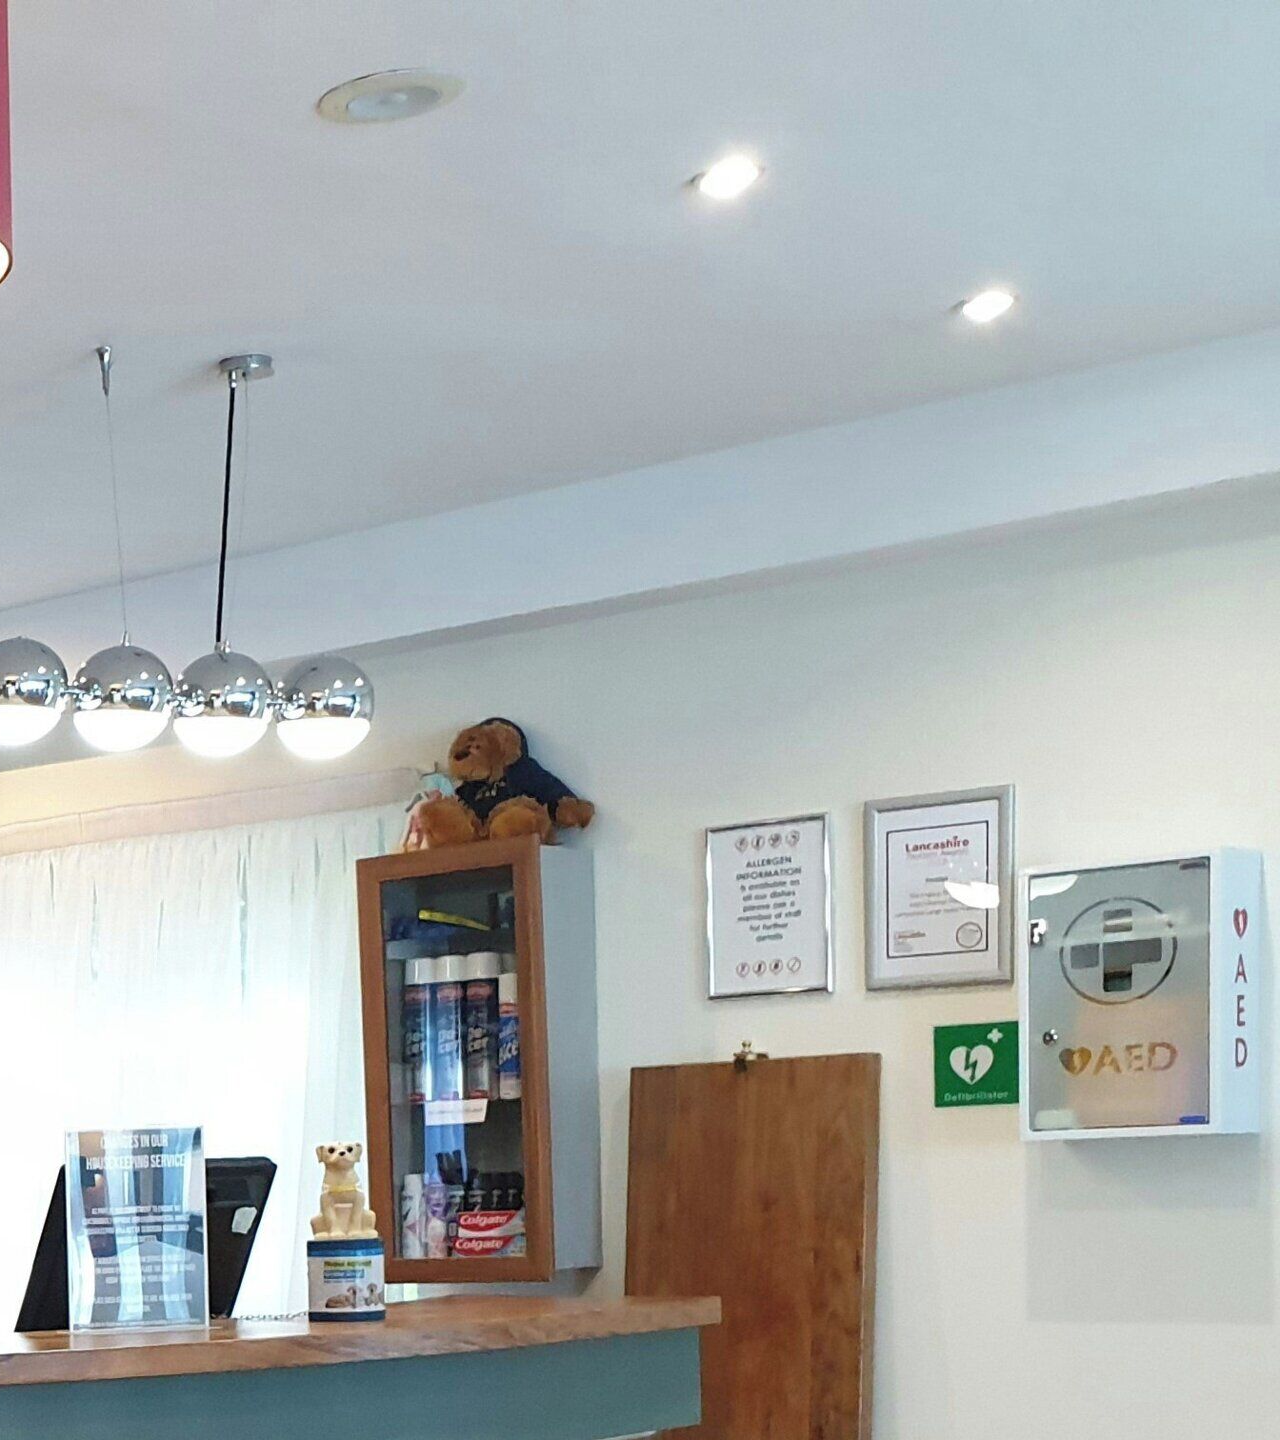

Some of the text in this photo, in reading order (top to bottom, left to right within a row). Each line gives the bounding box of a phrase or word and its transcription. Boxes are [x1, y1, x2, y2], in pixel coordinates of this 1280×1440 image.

[905, 835, 970, 852] Lancashire
[746, 856, 792, 868] ALLERGEN
[736, 866, 801, 880] INFORMATION
[1093, 1041, 1179, 1076] AED
[943, 1091, 1009, 1102] Defibrillator
[140, 1134, 150, 1147] IN
[151, 1134, 169, 1147] OUR
[86, 1154, 149, 1171] HOUSEKEEPING
[460, 1214, 509, 1227] Colgate
[455, 1239, 504, 1251] Colgate
